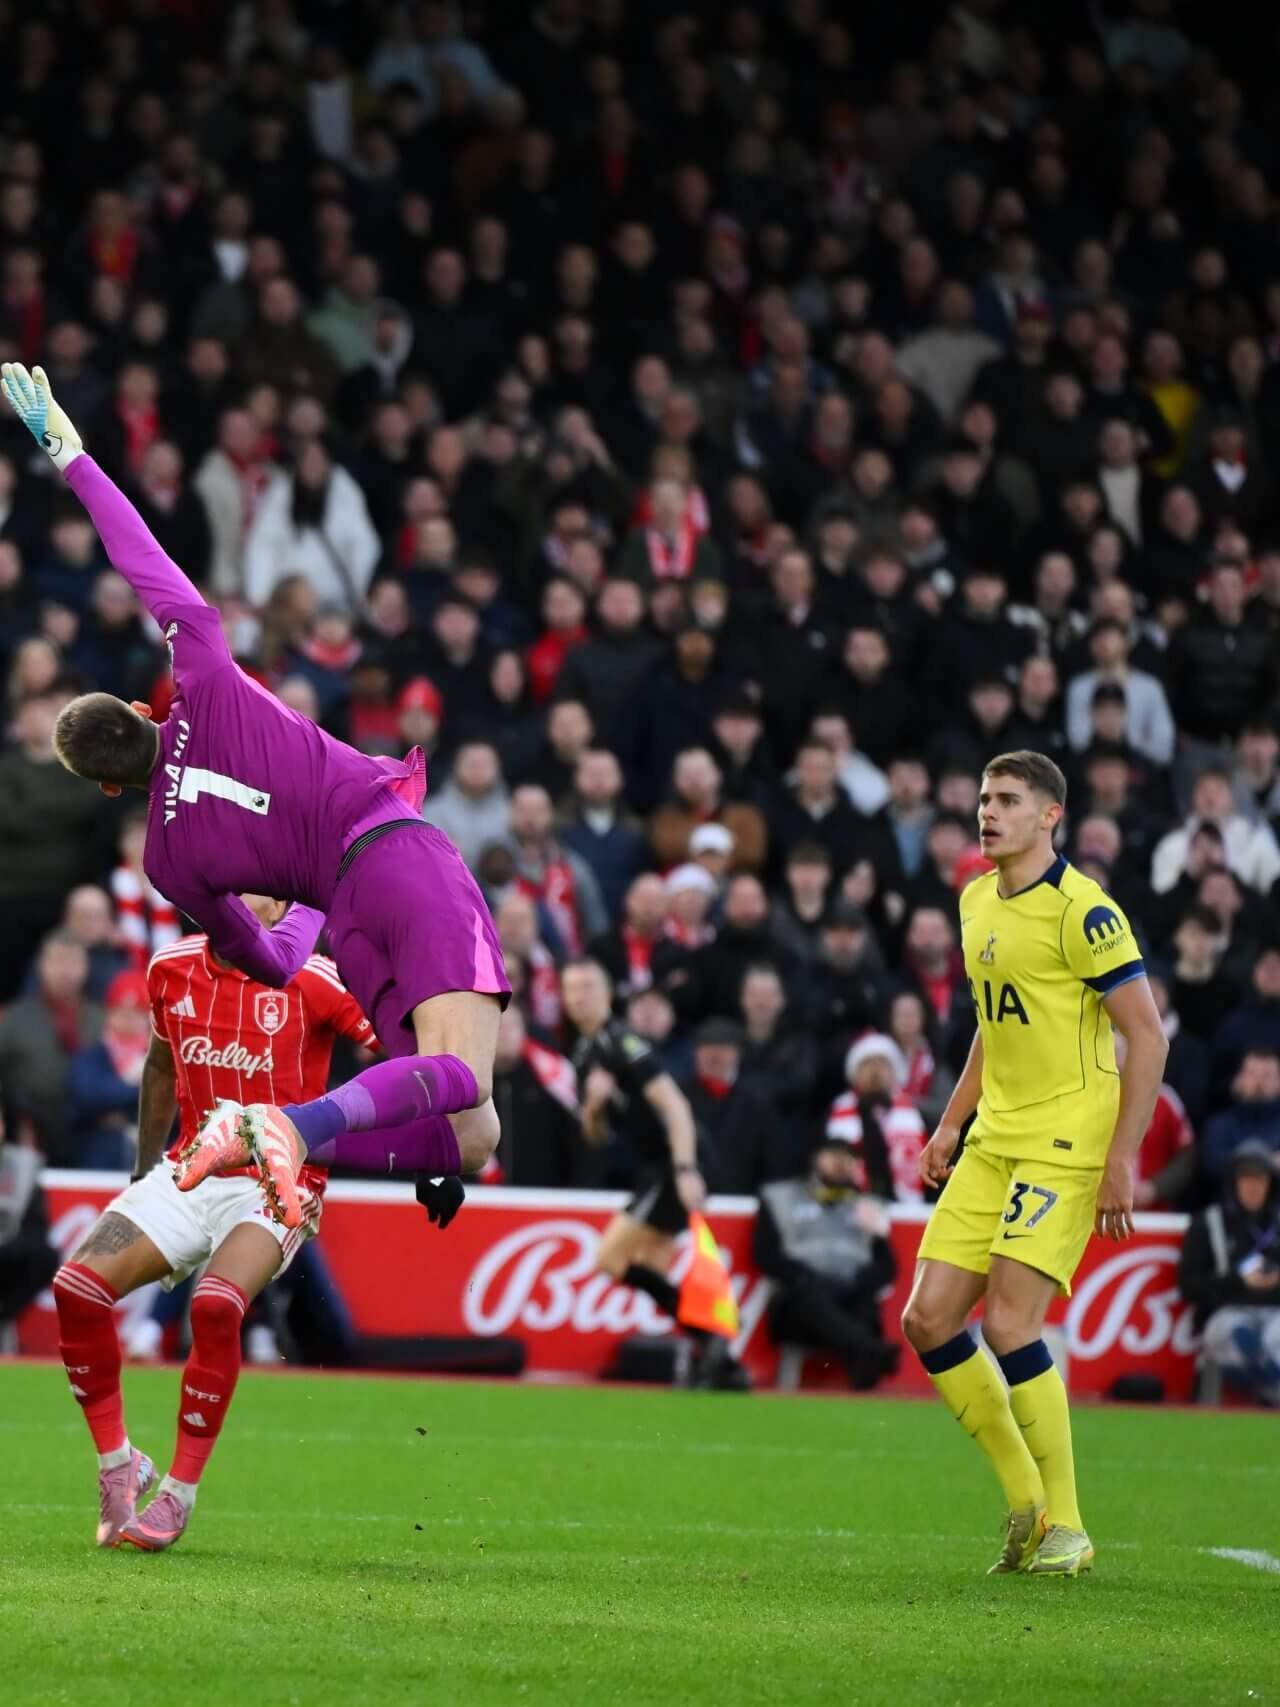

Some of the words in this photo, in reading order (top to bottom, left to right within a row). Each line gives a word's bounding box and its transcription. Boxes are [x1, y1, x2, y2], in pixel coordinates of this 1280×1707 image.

[178, 765, 271, 816] 1
[180, 1035, 274, 1079] Bally's
[1004, 1181, 1058, 1228] 37
